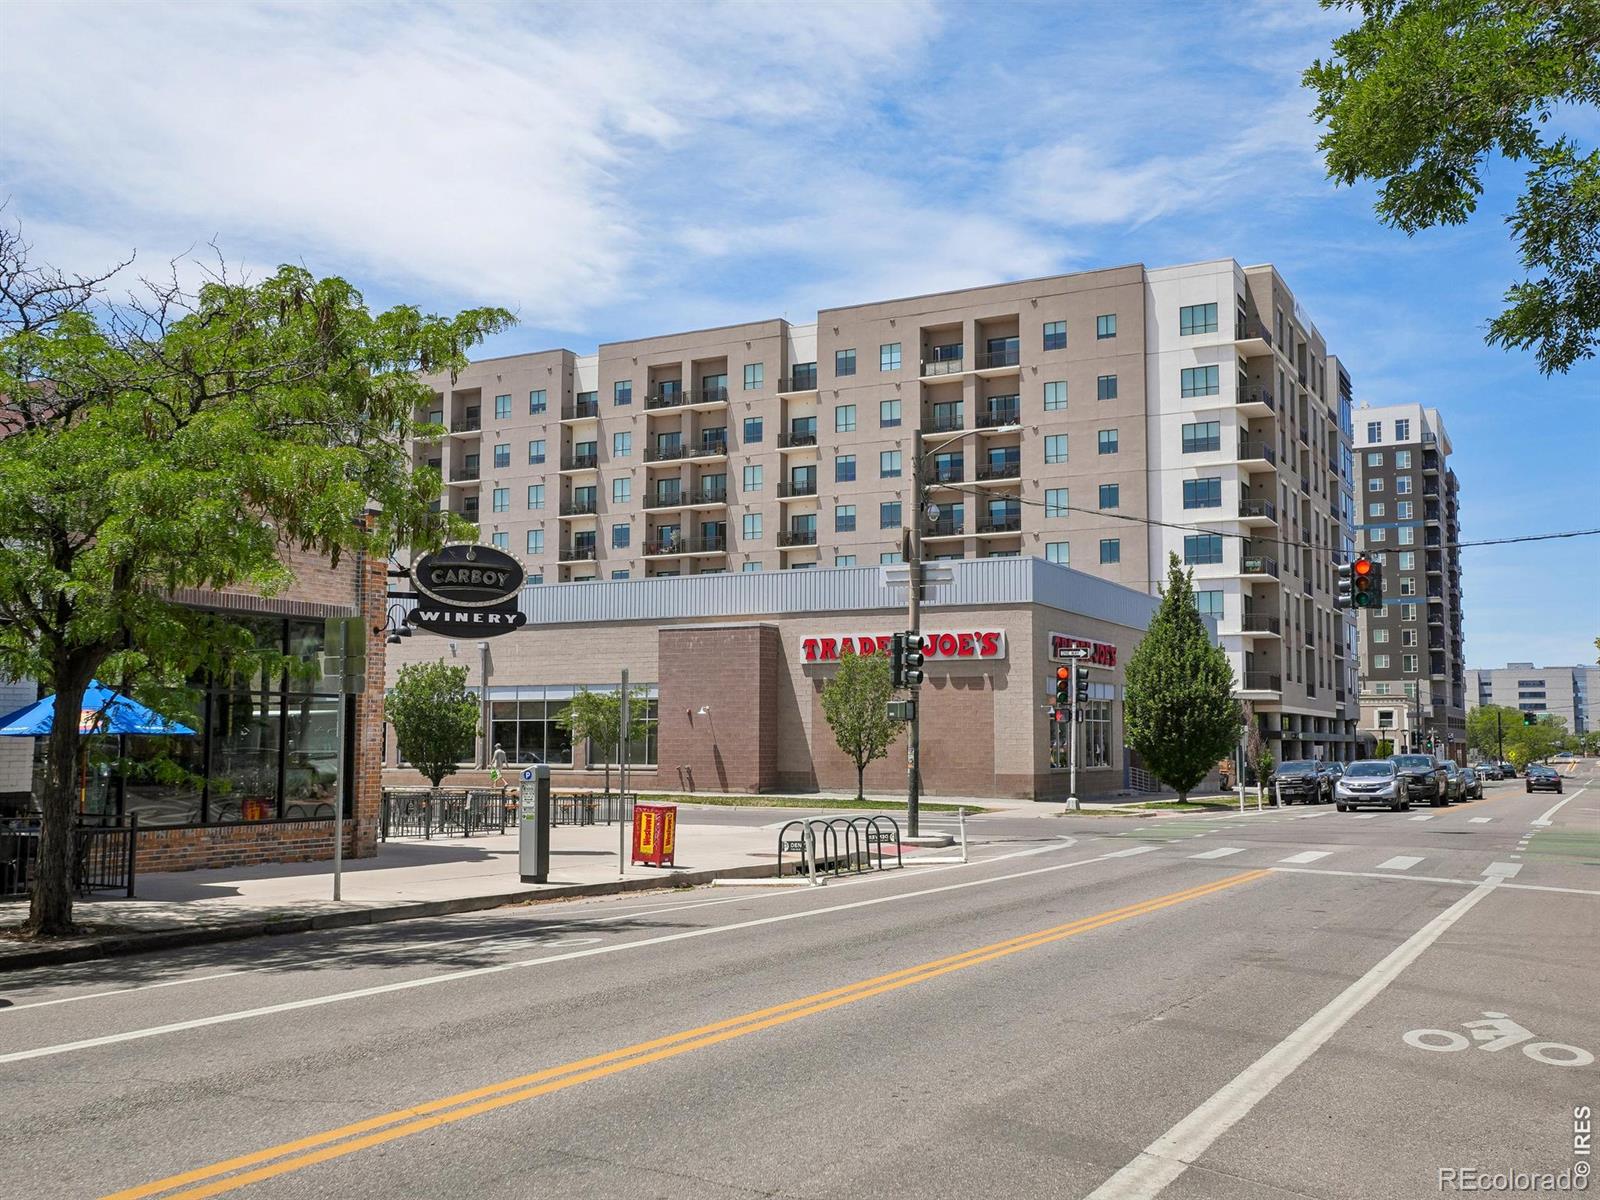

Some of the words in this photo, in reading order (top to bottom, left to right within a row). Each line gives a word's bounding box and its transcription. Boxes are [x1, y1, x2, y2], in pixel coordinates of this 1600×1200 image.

[431, 568, 510, 587] CARBOY
[419, 611, 518, 624] WINERY
[802, 635, 893, 662] TRADE
[921, 631, 1001, 657] JOE'S
